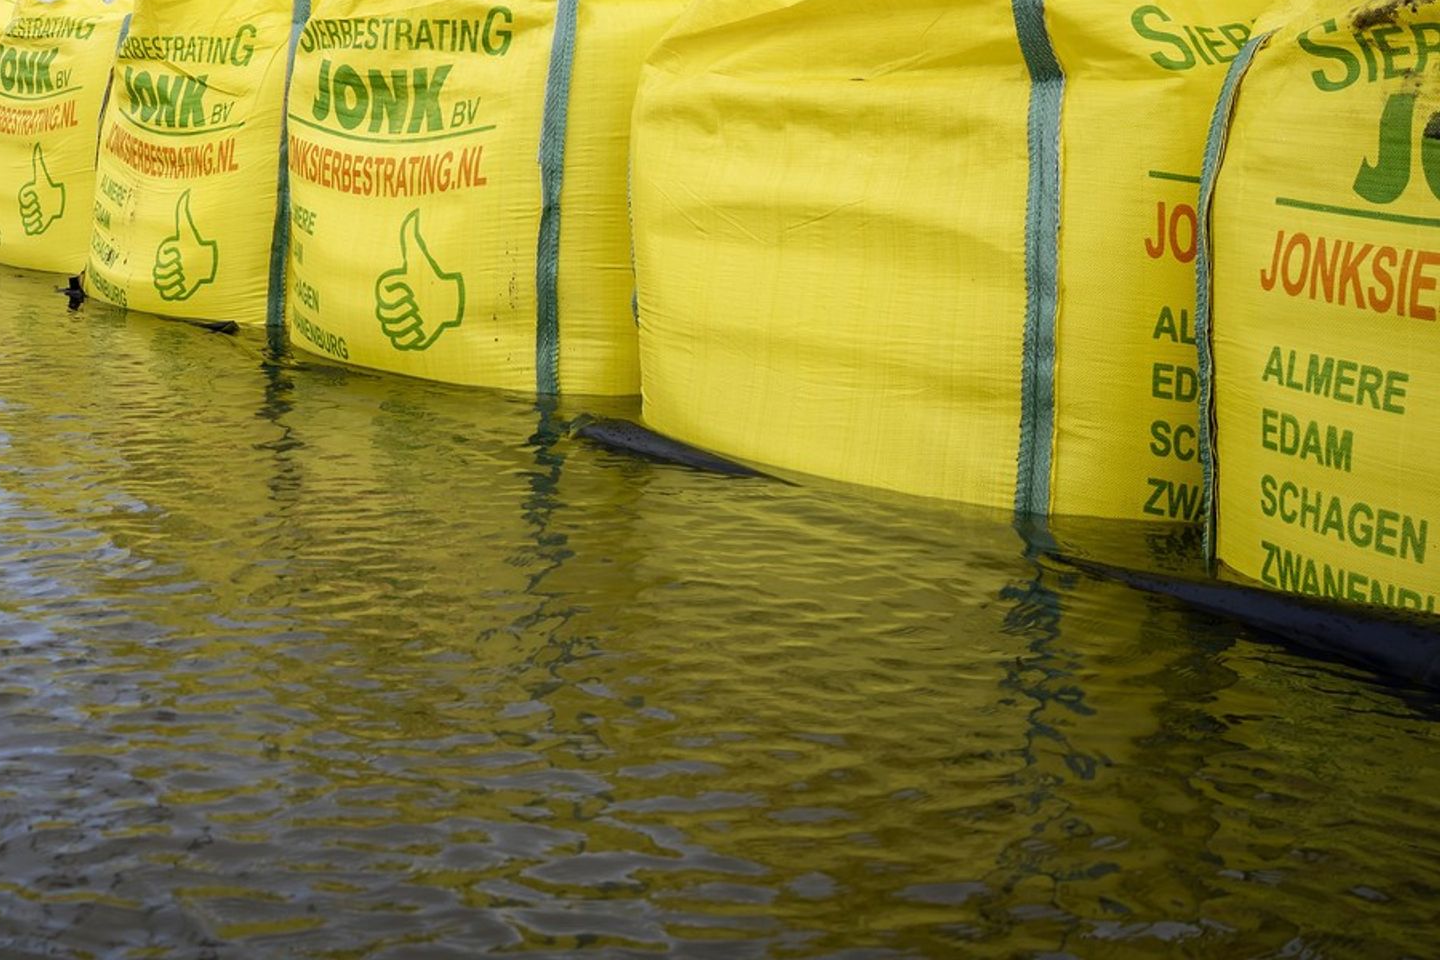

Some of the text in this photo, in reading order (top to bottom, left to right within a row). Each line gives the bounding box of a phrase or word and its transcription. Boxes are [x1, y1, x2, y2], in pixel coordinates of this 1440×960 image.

[1131, 5, 1256, 71] SIER
[1298, 18, 1440, 91] SIER
[56, 68, 72, 89] BV
[125, 66, 235, 128] JONK BV
[312, 58, 481, 134] JONK BV
[1151, 362, 1203, 403] ED
[1262, 345, 1410, 415] ALMERE
[1149, 419, 1203, 463] SC
[1262, 407, 1354, 473] EDAM
[1261, 474, 1428, 564] SCHAGEN
